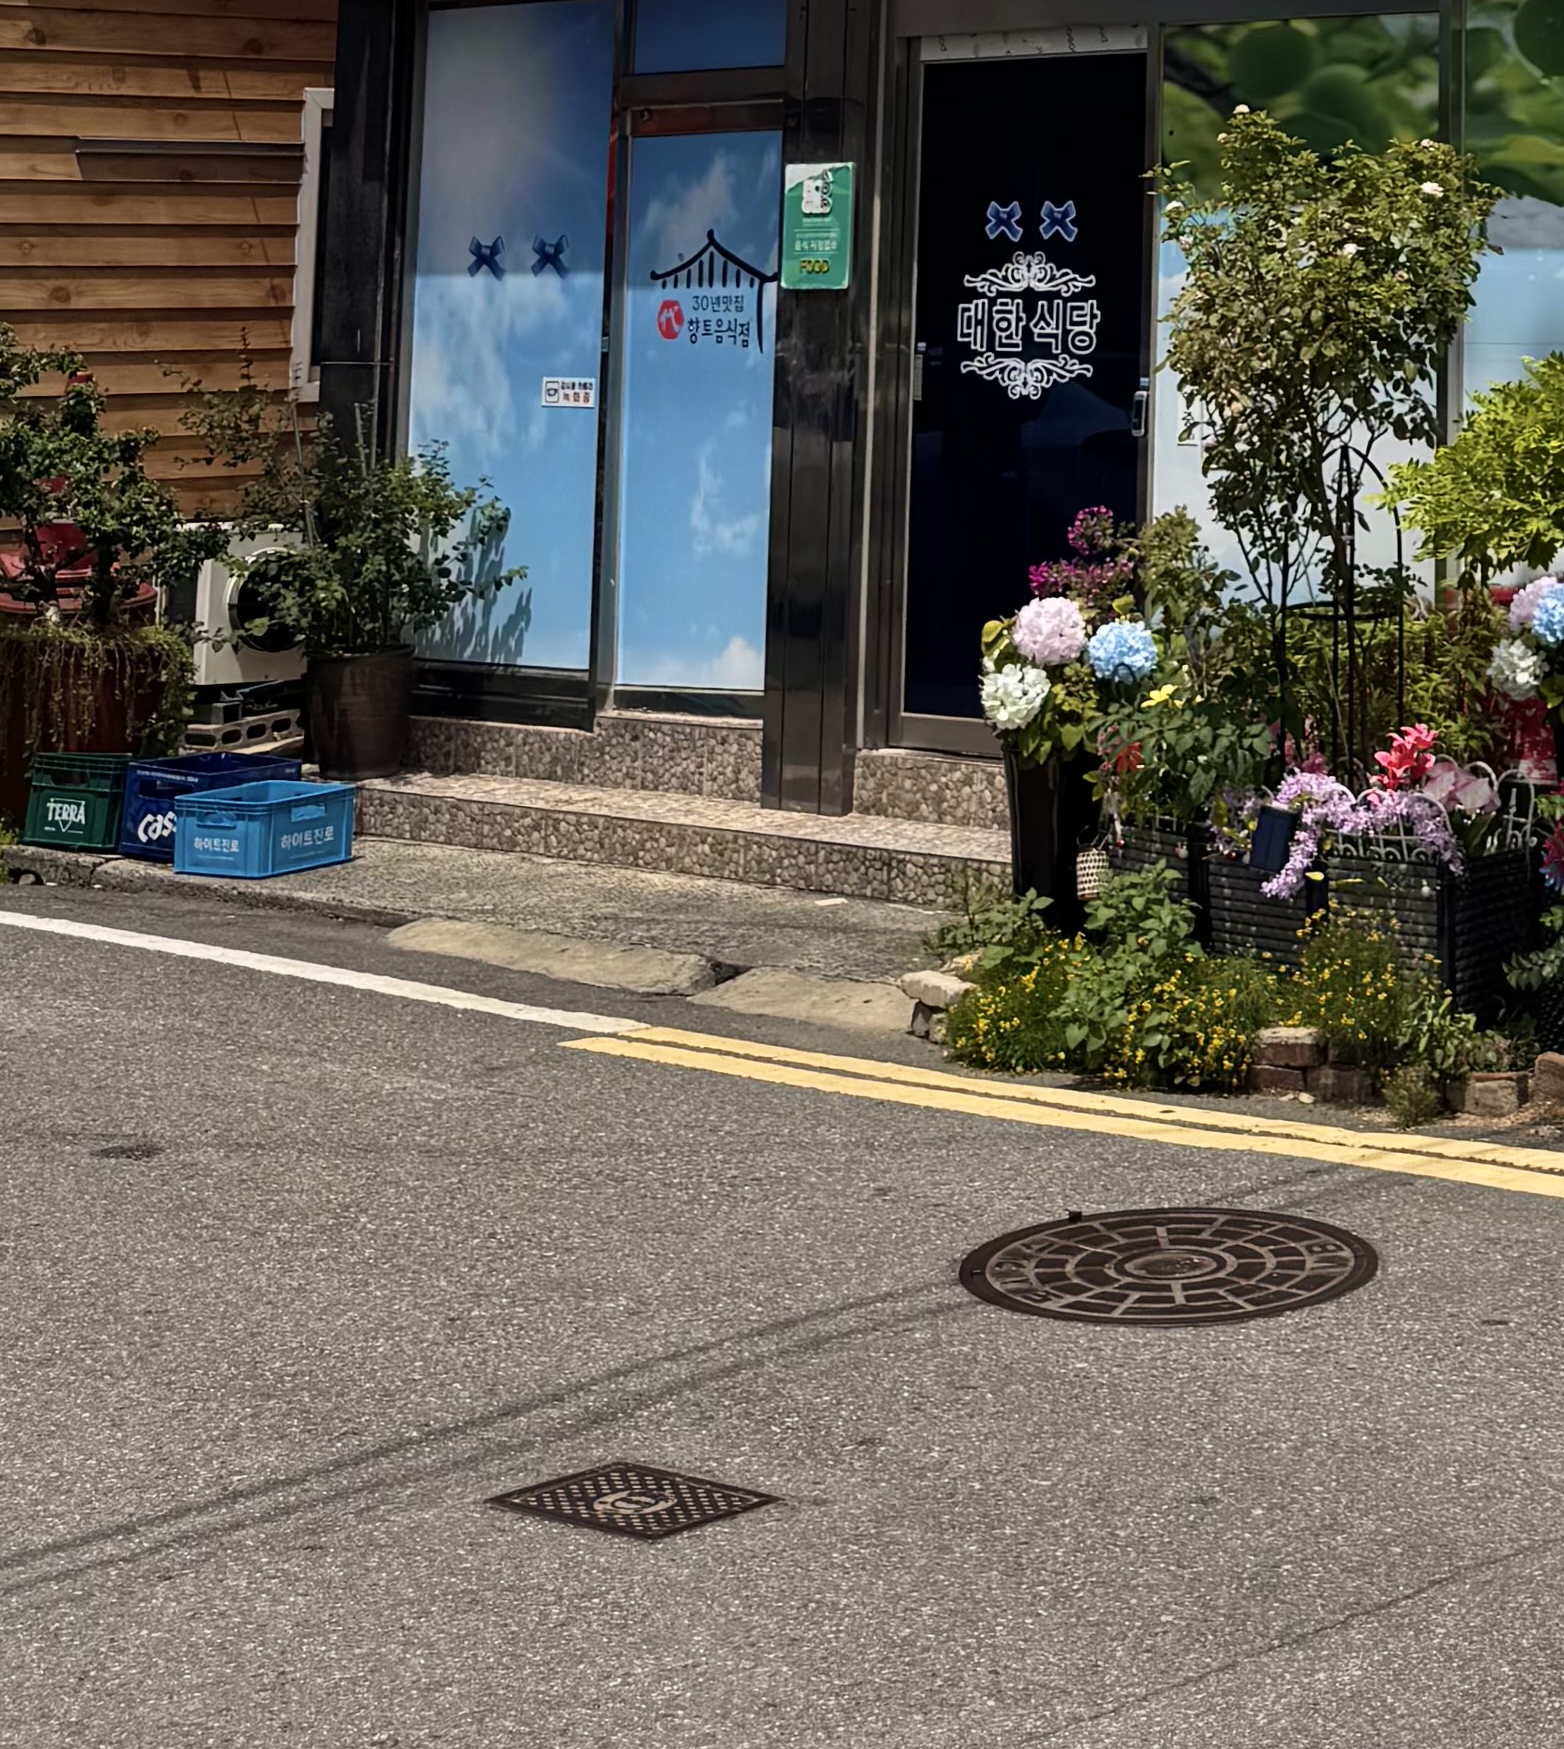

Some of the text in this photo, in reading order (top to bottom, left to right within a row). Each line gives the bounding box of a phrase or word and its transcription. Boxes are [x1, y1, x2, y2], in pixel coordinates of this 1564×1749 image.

[692, 294, 744, 313] 30년맛집
[687, 317, 750, 348] 향토음식점
[956, 298, 1101, 355] 대한식당
[46, 800, 86, 826] TERRA
[193, 836, 240, 853] 하이트진로
[280, 825, 335, 850] 하이트진로
